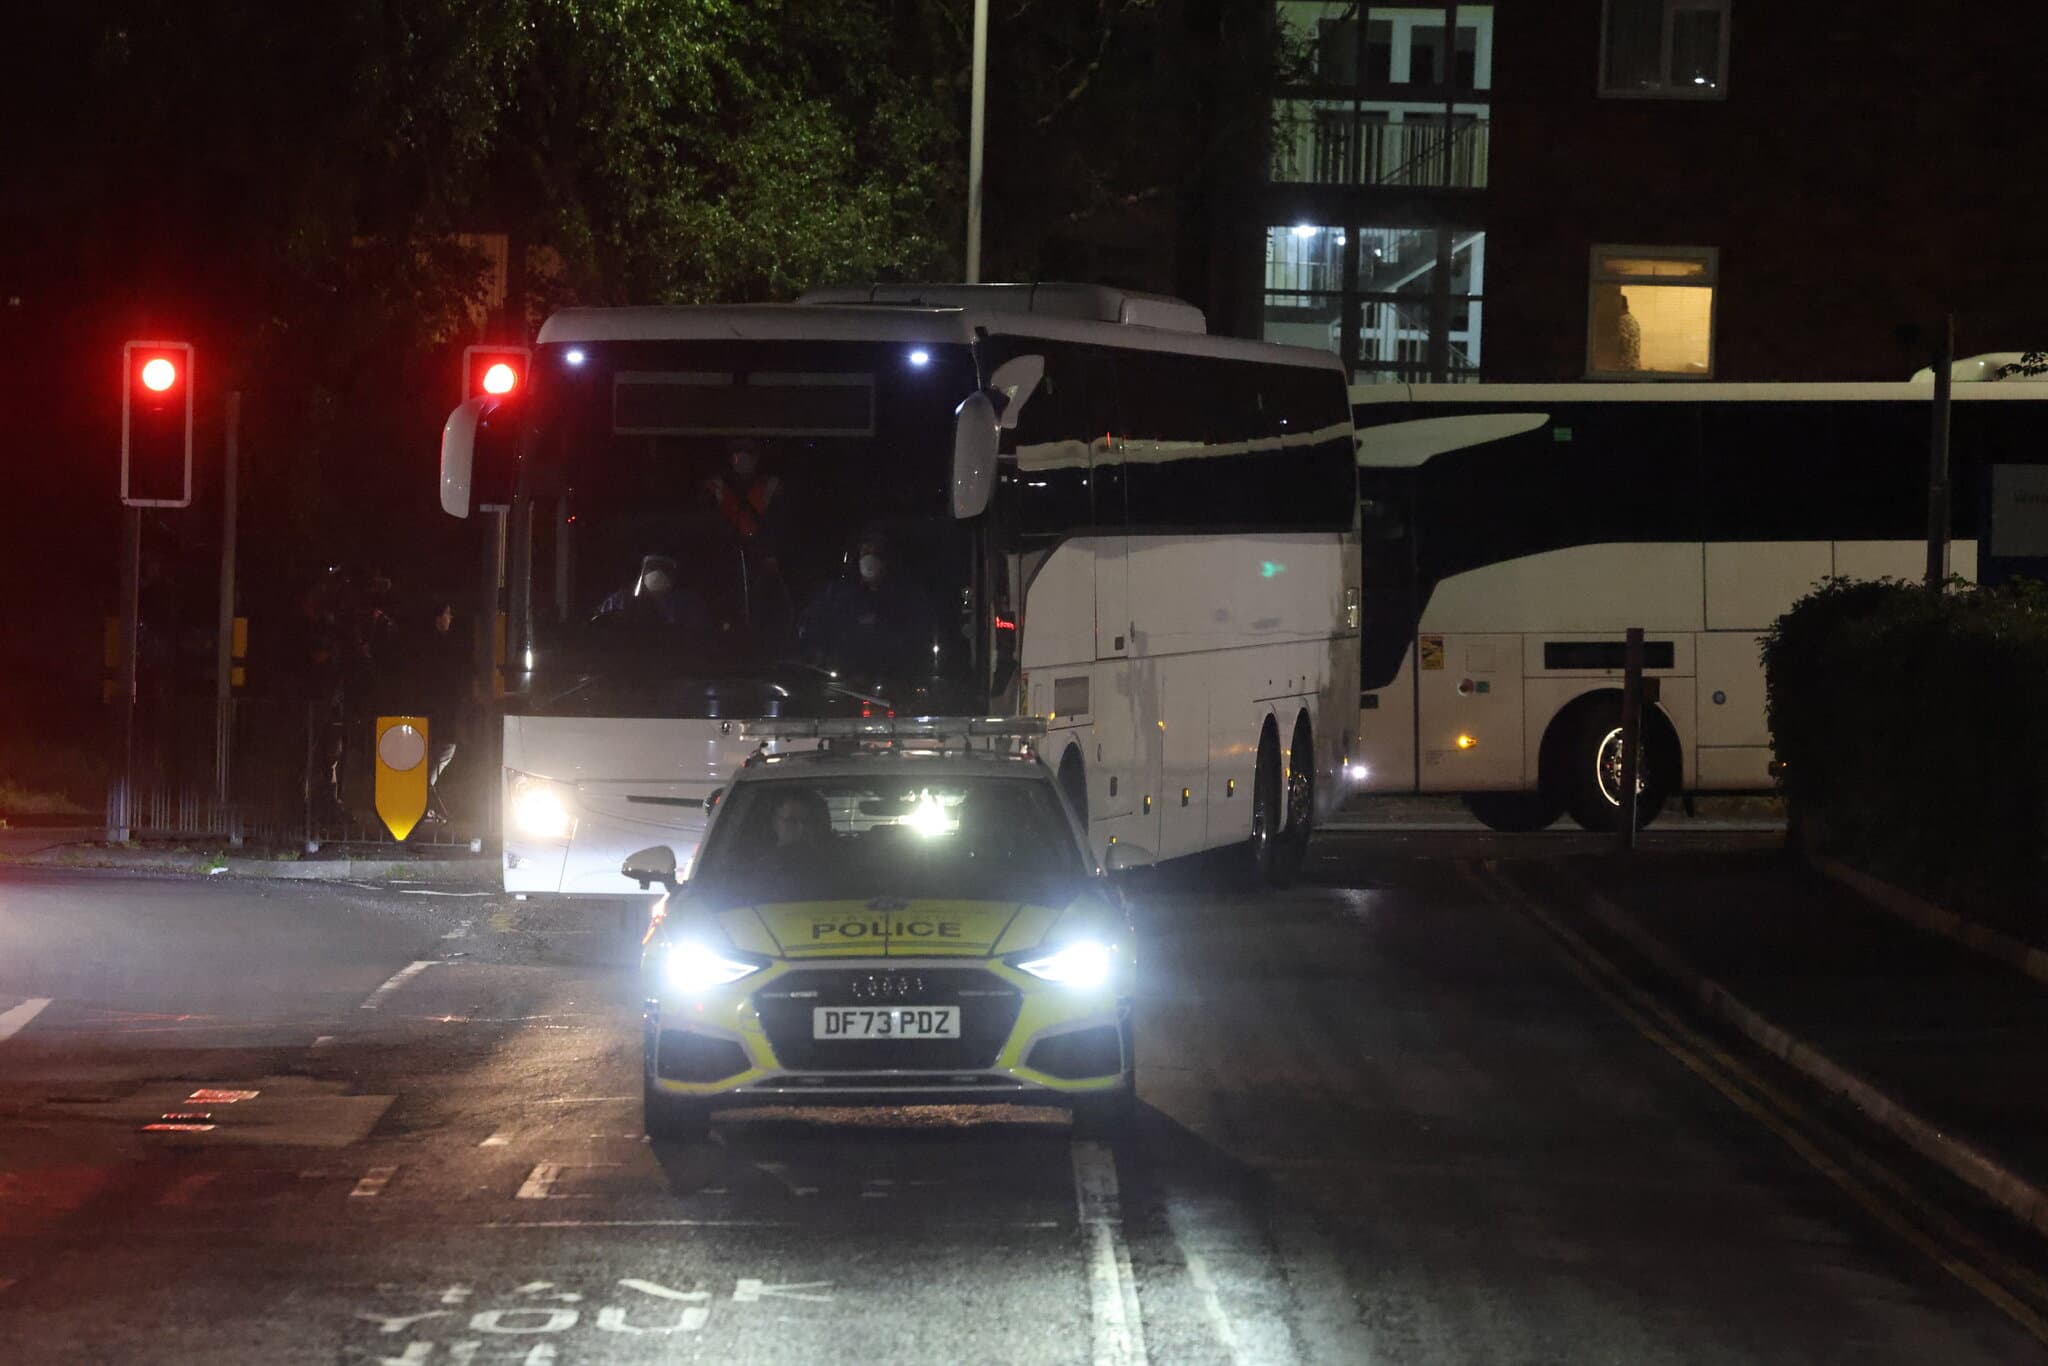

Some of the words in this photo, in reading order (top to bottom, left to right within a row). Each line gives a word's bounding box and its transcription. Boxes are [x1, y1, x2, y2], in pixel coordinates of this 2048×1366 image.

[813, 921, 960, 938] POLICE
[825, 1011, 892, 1034] DF73
[900, 1011, 949, 1034] PDZ
